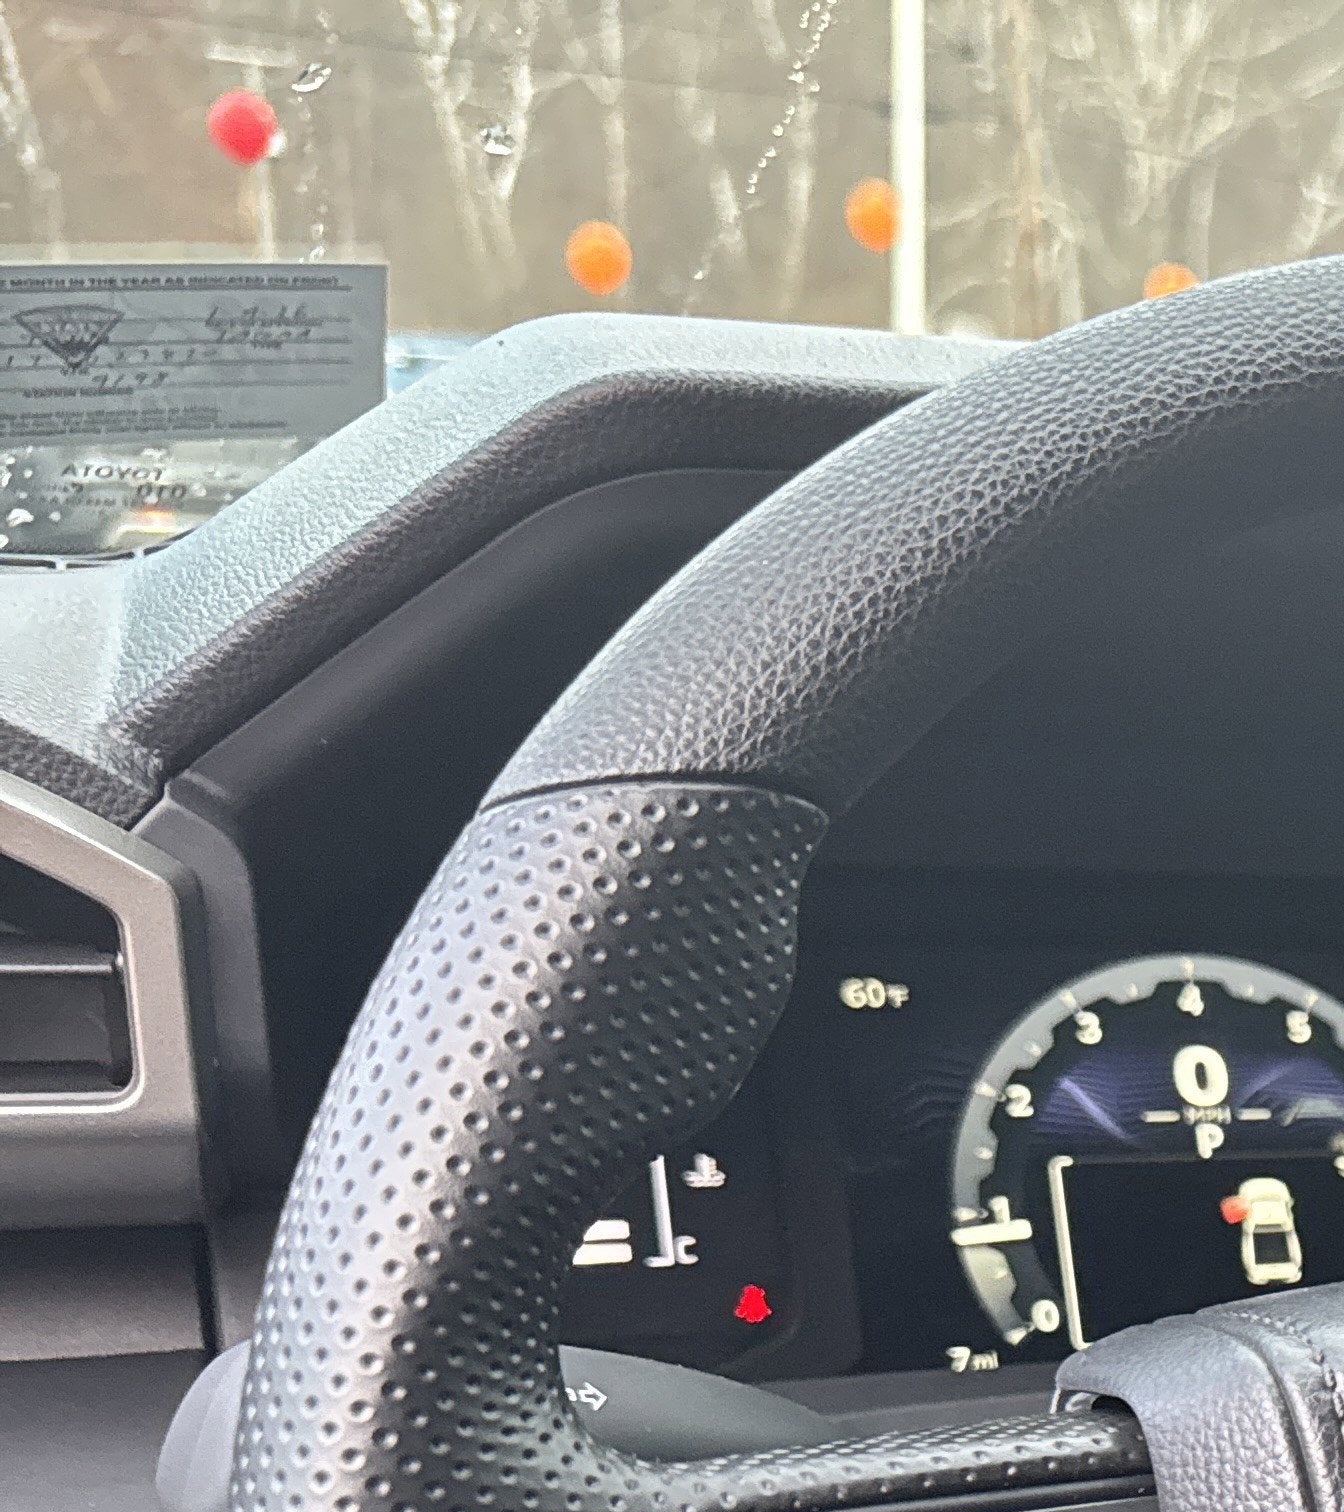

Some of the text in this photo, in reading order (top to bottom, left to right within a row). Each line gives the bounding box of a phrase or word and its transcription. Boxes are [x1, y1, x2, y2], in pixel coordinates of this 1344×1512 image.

[1178, 984, 1205, 1017] 4
[1077, 1012, 1103, 1046] 3
[1286, 1012, 1312, 1044] 5
[1173, 1044, 1229, 1107] 0
[1004, 1083, 1034, 1118] 2
[1195, 1123, 1225, 1159] P
[1031, 1300, 1060, 1334] 0
[946, 1346, 999, 1372] 7 mi
